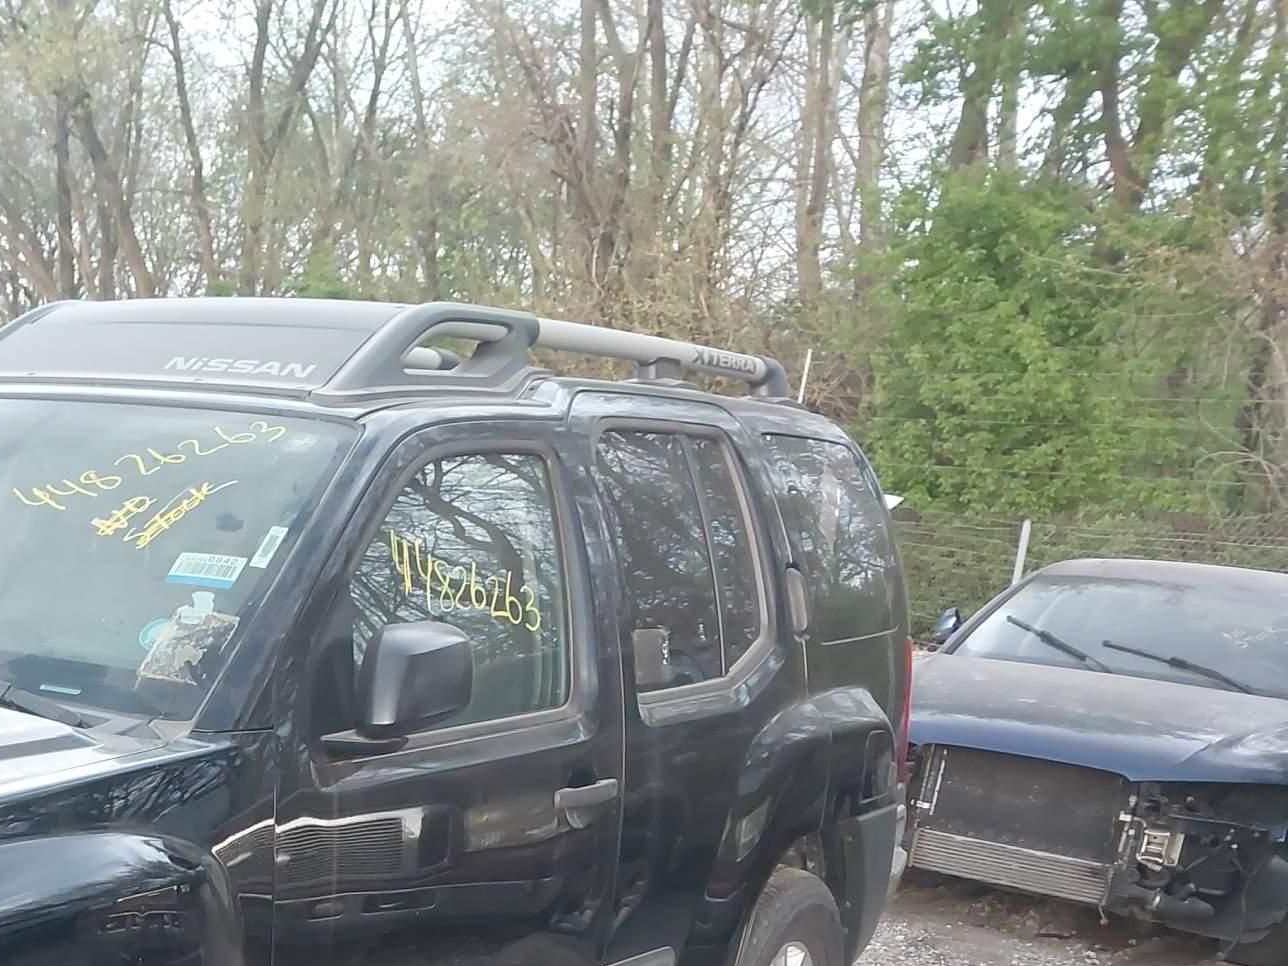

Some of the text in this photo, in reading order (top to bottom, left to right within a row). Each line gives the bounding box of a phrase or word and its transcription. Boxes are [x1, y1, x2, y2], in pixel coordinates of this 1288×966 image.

[693, 346, 757, 375] XTERRA
[13, 421, 286, 511] 44826263
[390, 529, 541, 631] 44826263
